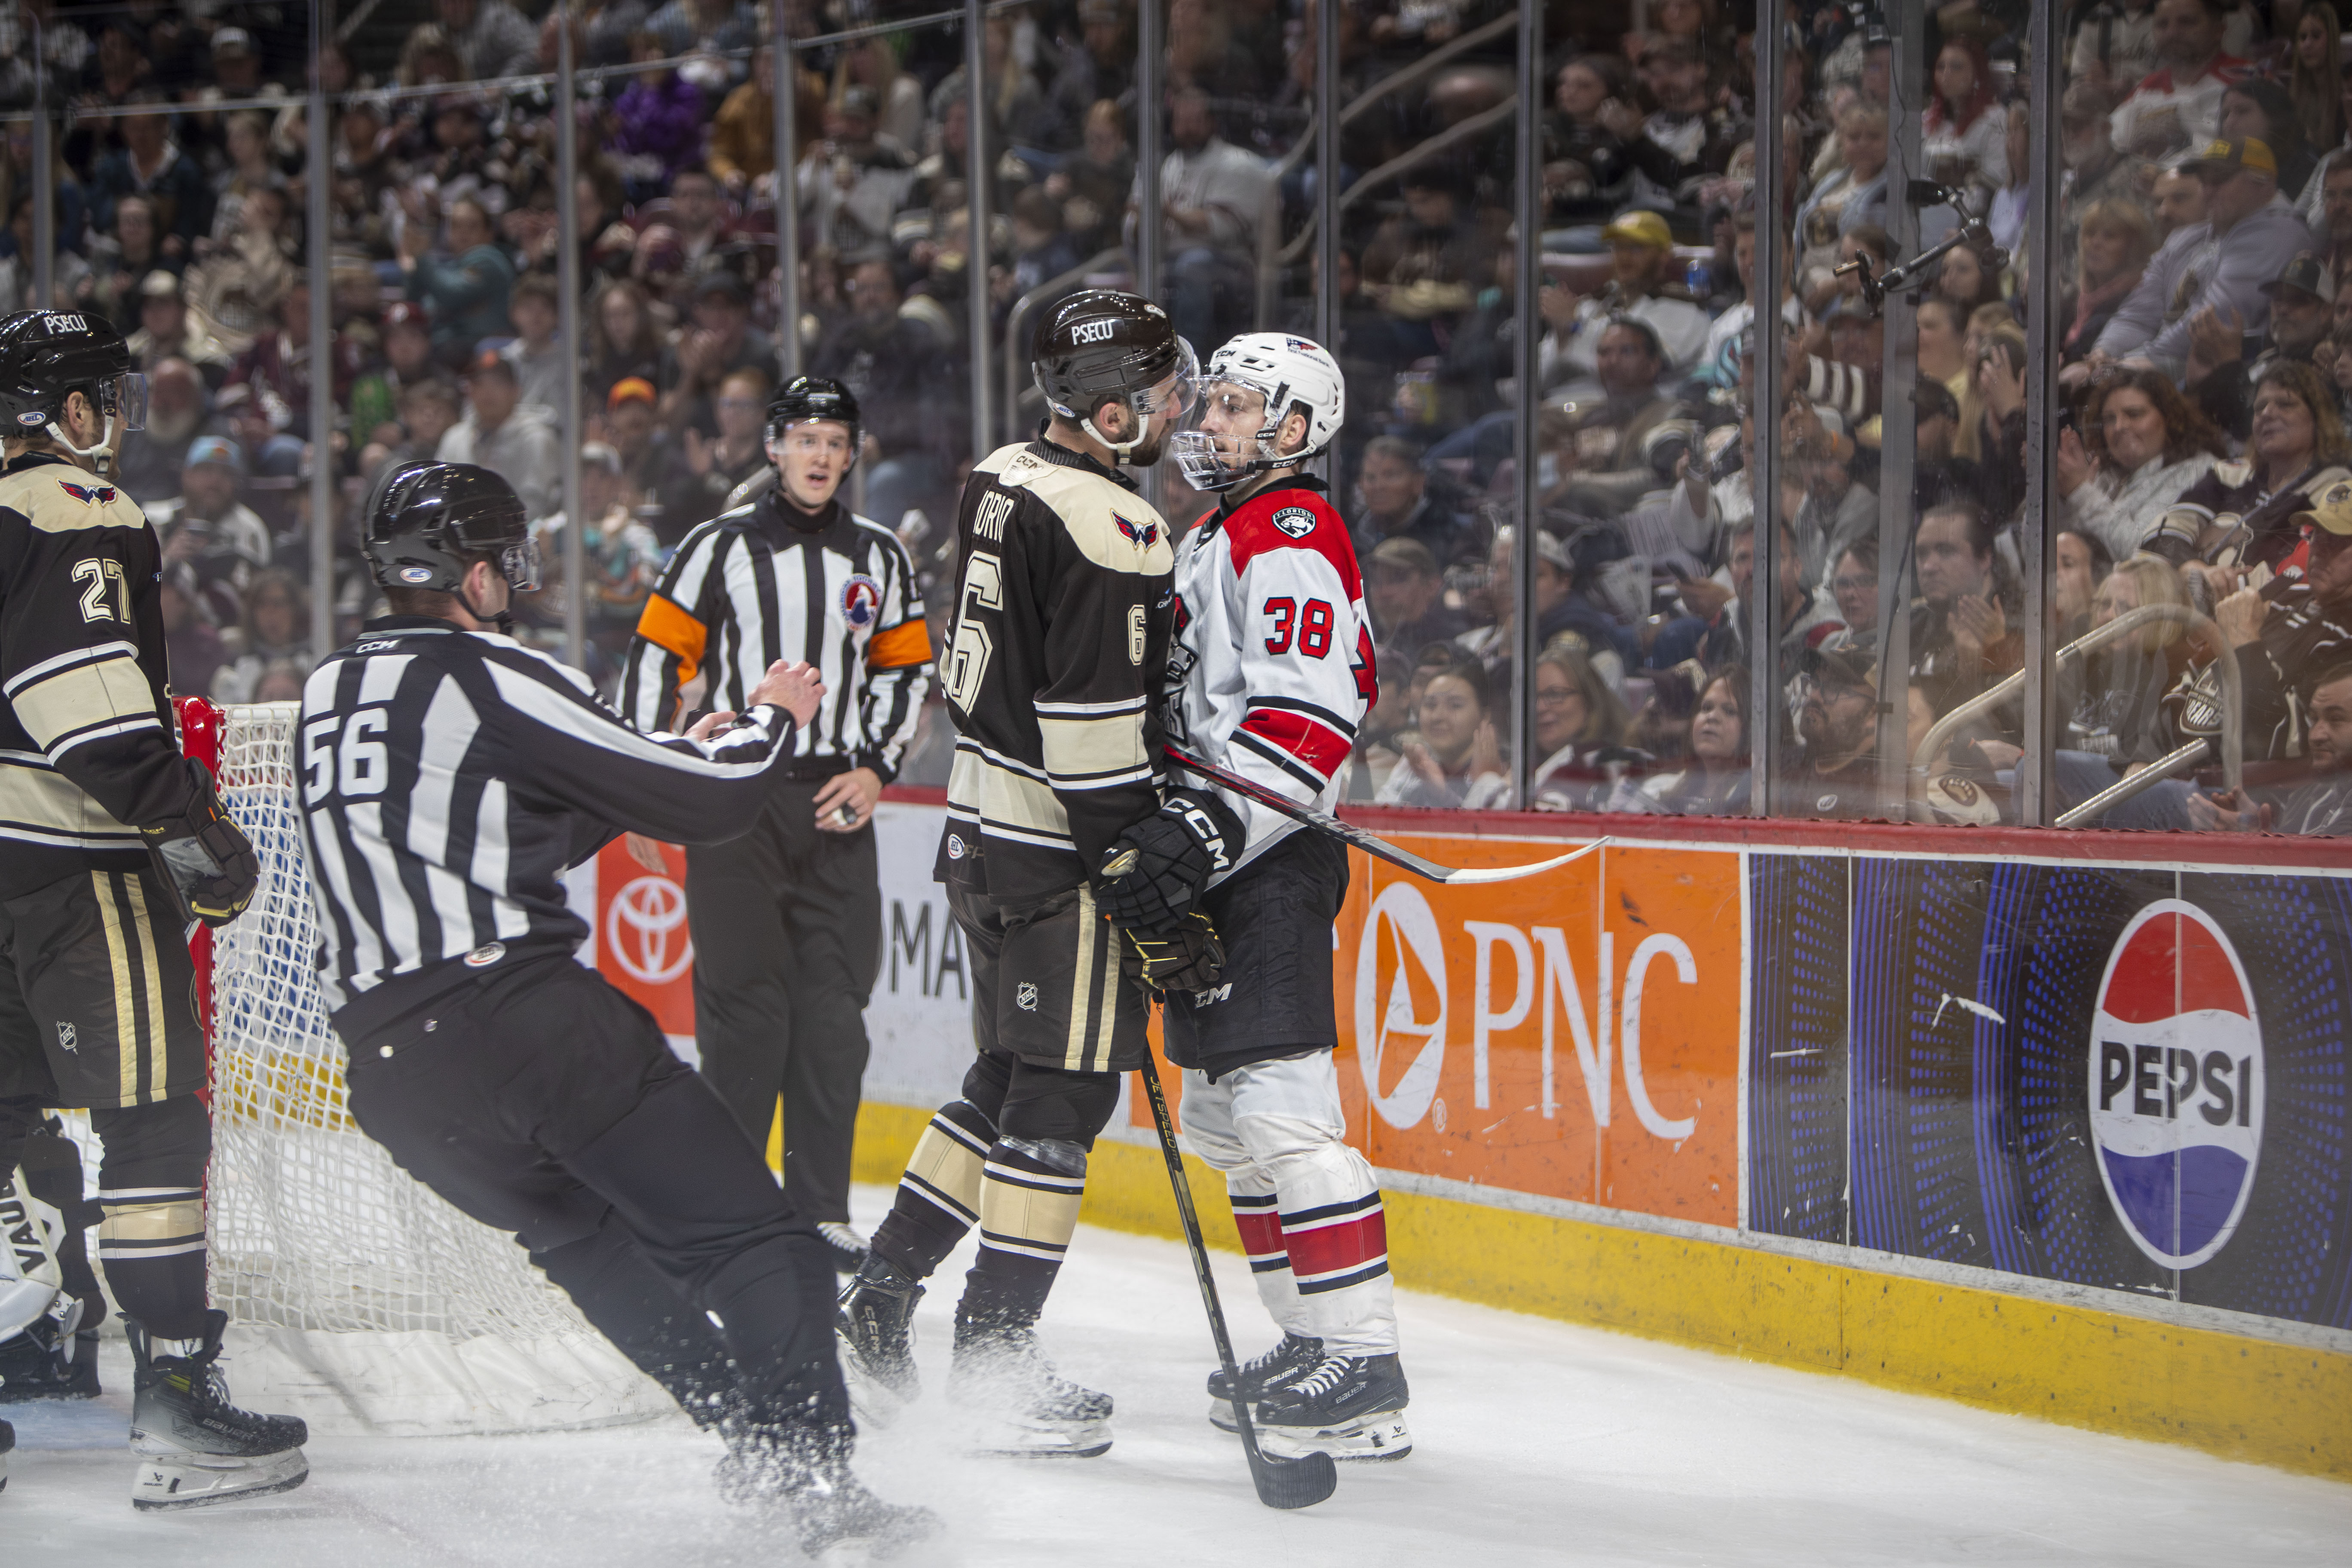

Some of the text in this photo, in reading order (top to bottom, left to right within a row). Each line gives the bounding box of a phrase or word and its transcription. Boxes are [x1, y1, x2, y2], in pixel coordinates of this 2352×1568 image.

[43, 315, 88, 334] PSECU
[1072, 320, 1114, 345] PSECU
[1272, 458, 1298, 469] CCM
[973, 490, 1014, 544] IORIO
[1277, 508, 1312, 518] FLORIDA
[72, 558, 131, 624] 27
[355, 639, 400, 653] CCM
[946, 550, 1003, 717] 6
[1128, 604, 1146, 666] 6
[1264, 596, 1335, 660] 38
[304, 707, 389, 807] 56
[1162, 797, 1229, 870] CCM
[1307, 812, 1378, 844] CCM
[1195, 983, 1232, 1009] CM
[62, 1029, 73, 1042] NHL
[1464, 920, 1698, 1139] PNC
[2100, 1041, 2252, 1127] PEPSI
[1150, 1076, 1176, 1148] JETSPEED
[1262, 1366, 1299, 1387] BAUER
[1335, 1383, 1366, 1404] BAUER
